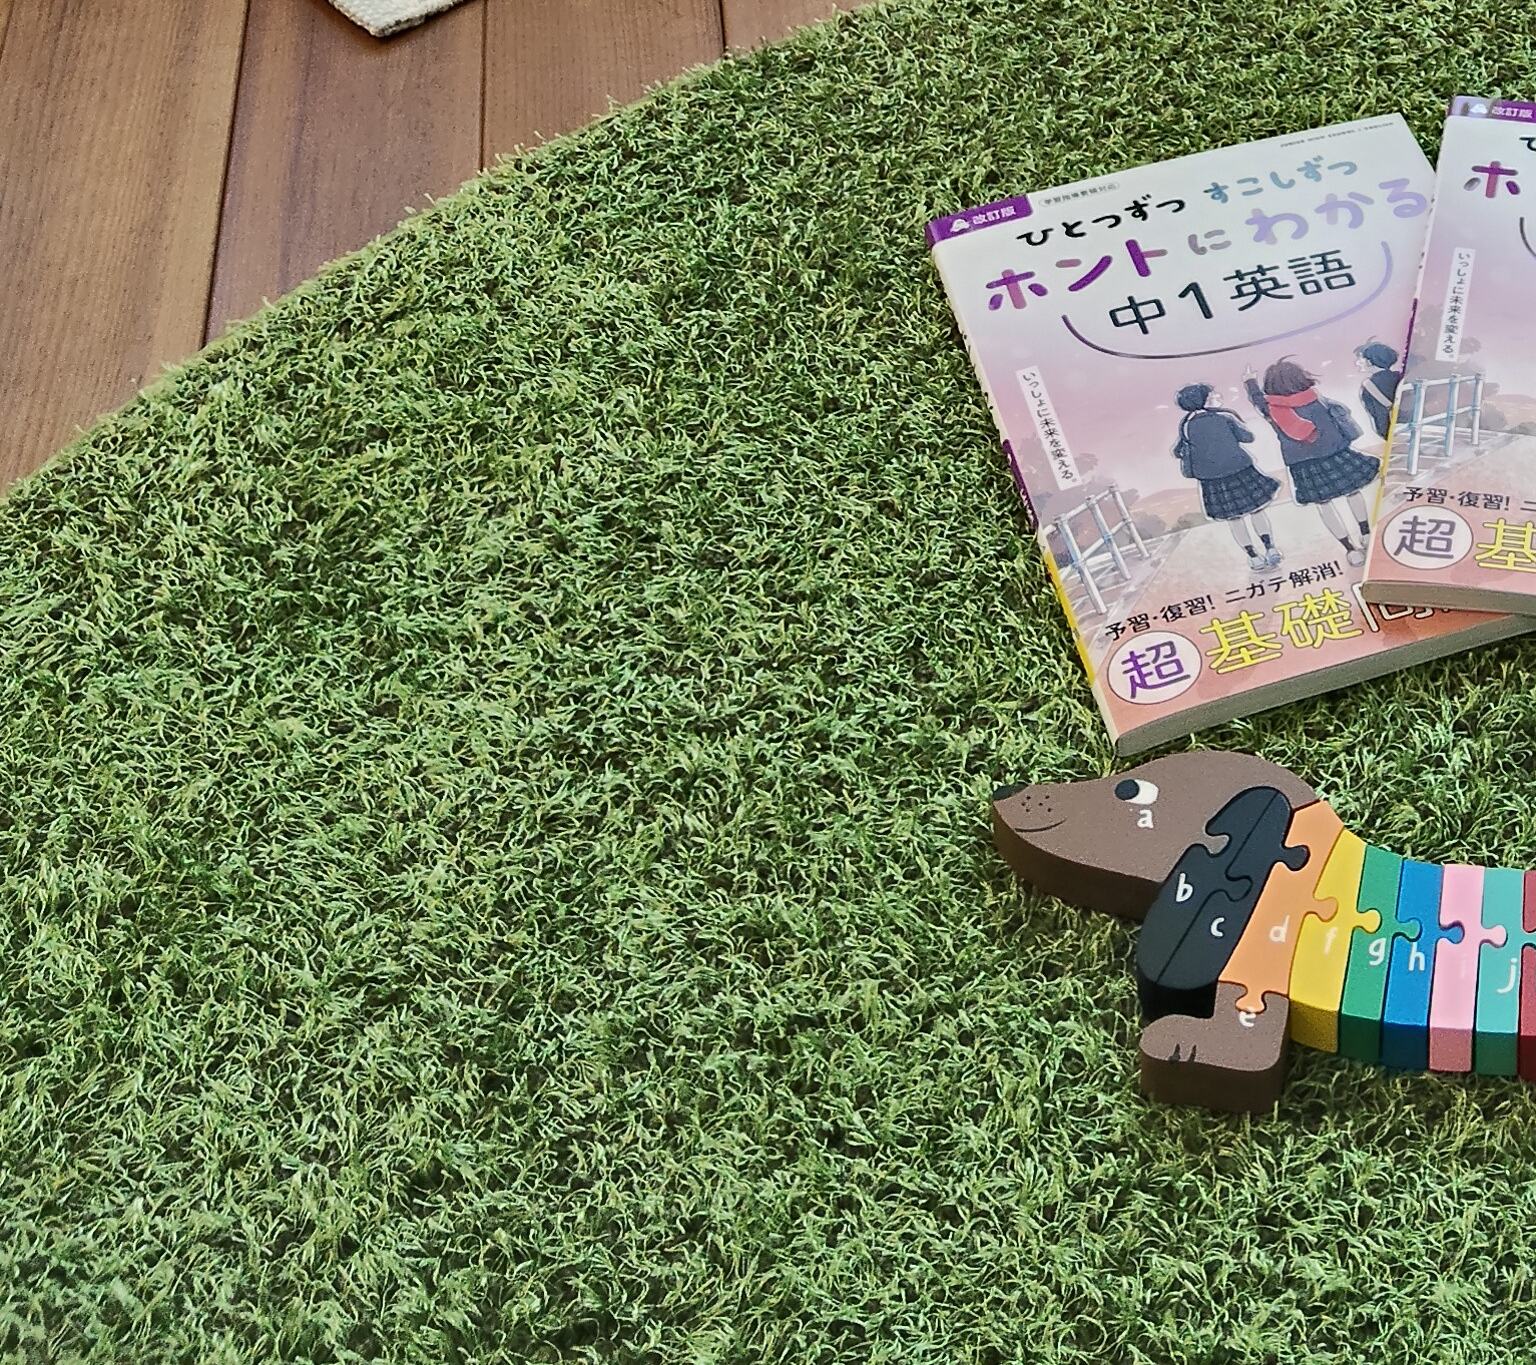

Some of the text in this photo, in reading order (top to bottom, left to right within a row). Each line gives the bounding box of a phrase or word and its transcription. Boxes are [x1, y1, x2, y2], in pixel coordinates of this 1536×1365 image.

[972, 205, 1017, 225] 改訂版
[1016, 155, 1358, 246] ひとつずつ すこしずつ
[985, 177, 1428, 310] ホントにわかる
[1109, 249, 1356, 335] 中1英語
[1443, 252, 1470, 358] いっしょに未来を変える。
[1022, 372, 1077, 482] いっしょに未来を変える。
[1393, 515, 1456, 559] 超
[1225, 560, 1345, 605] ニガテ解消!
[1121, 640, 1191, 700] 超
[1137, 809, 1154, 830] a
[1175, 874, 1193, 902] b
[1209, 916, 1225, 937] c
[1268, 914, 1289, 943] d
[1322, 926, 1338, 955] f
[1368, 935, 1386, 966] g
[1409, 942, 1425, 971] h
[1497, 956, 1519, 994] j
[1238, 1006, 1255, 1027] e
